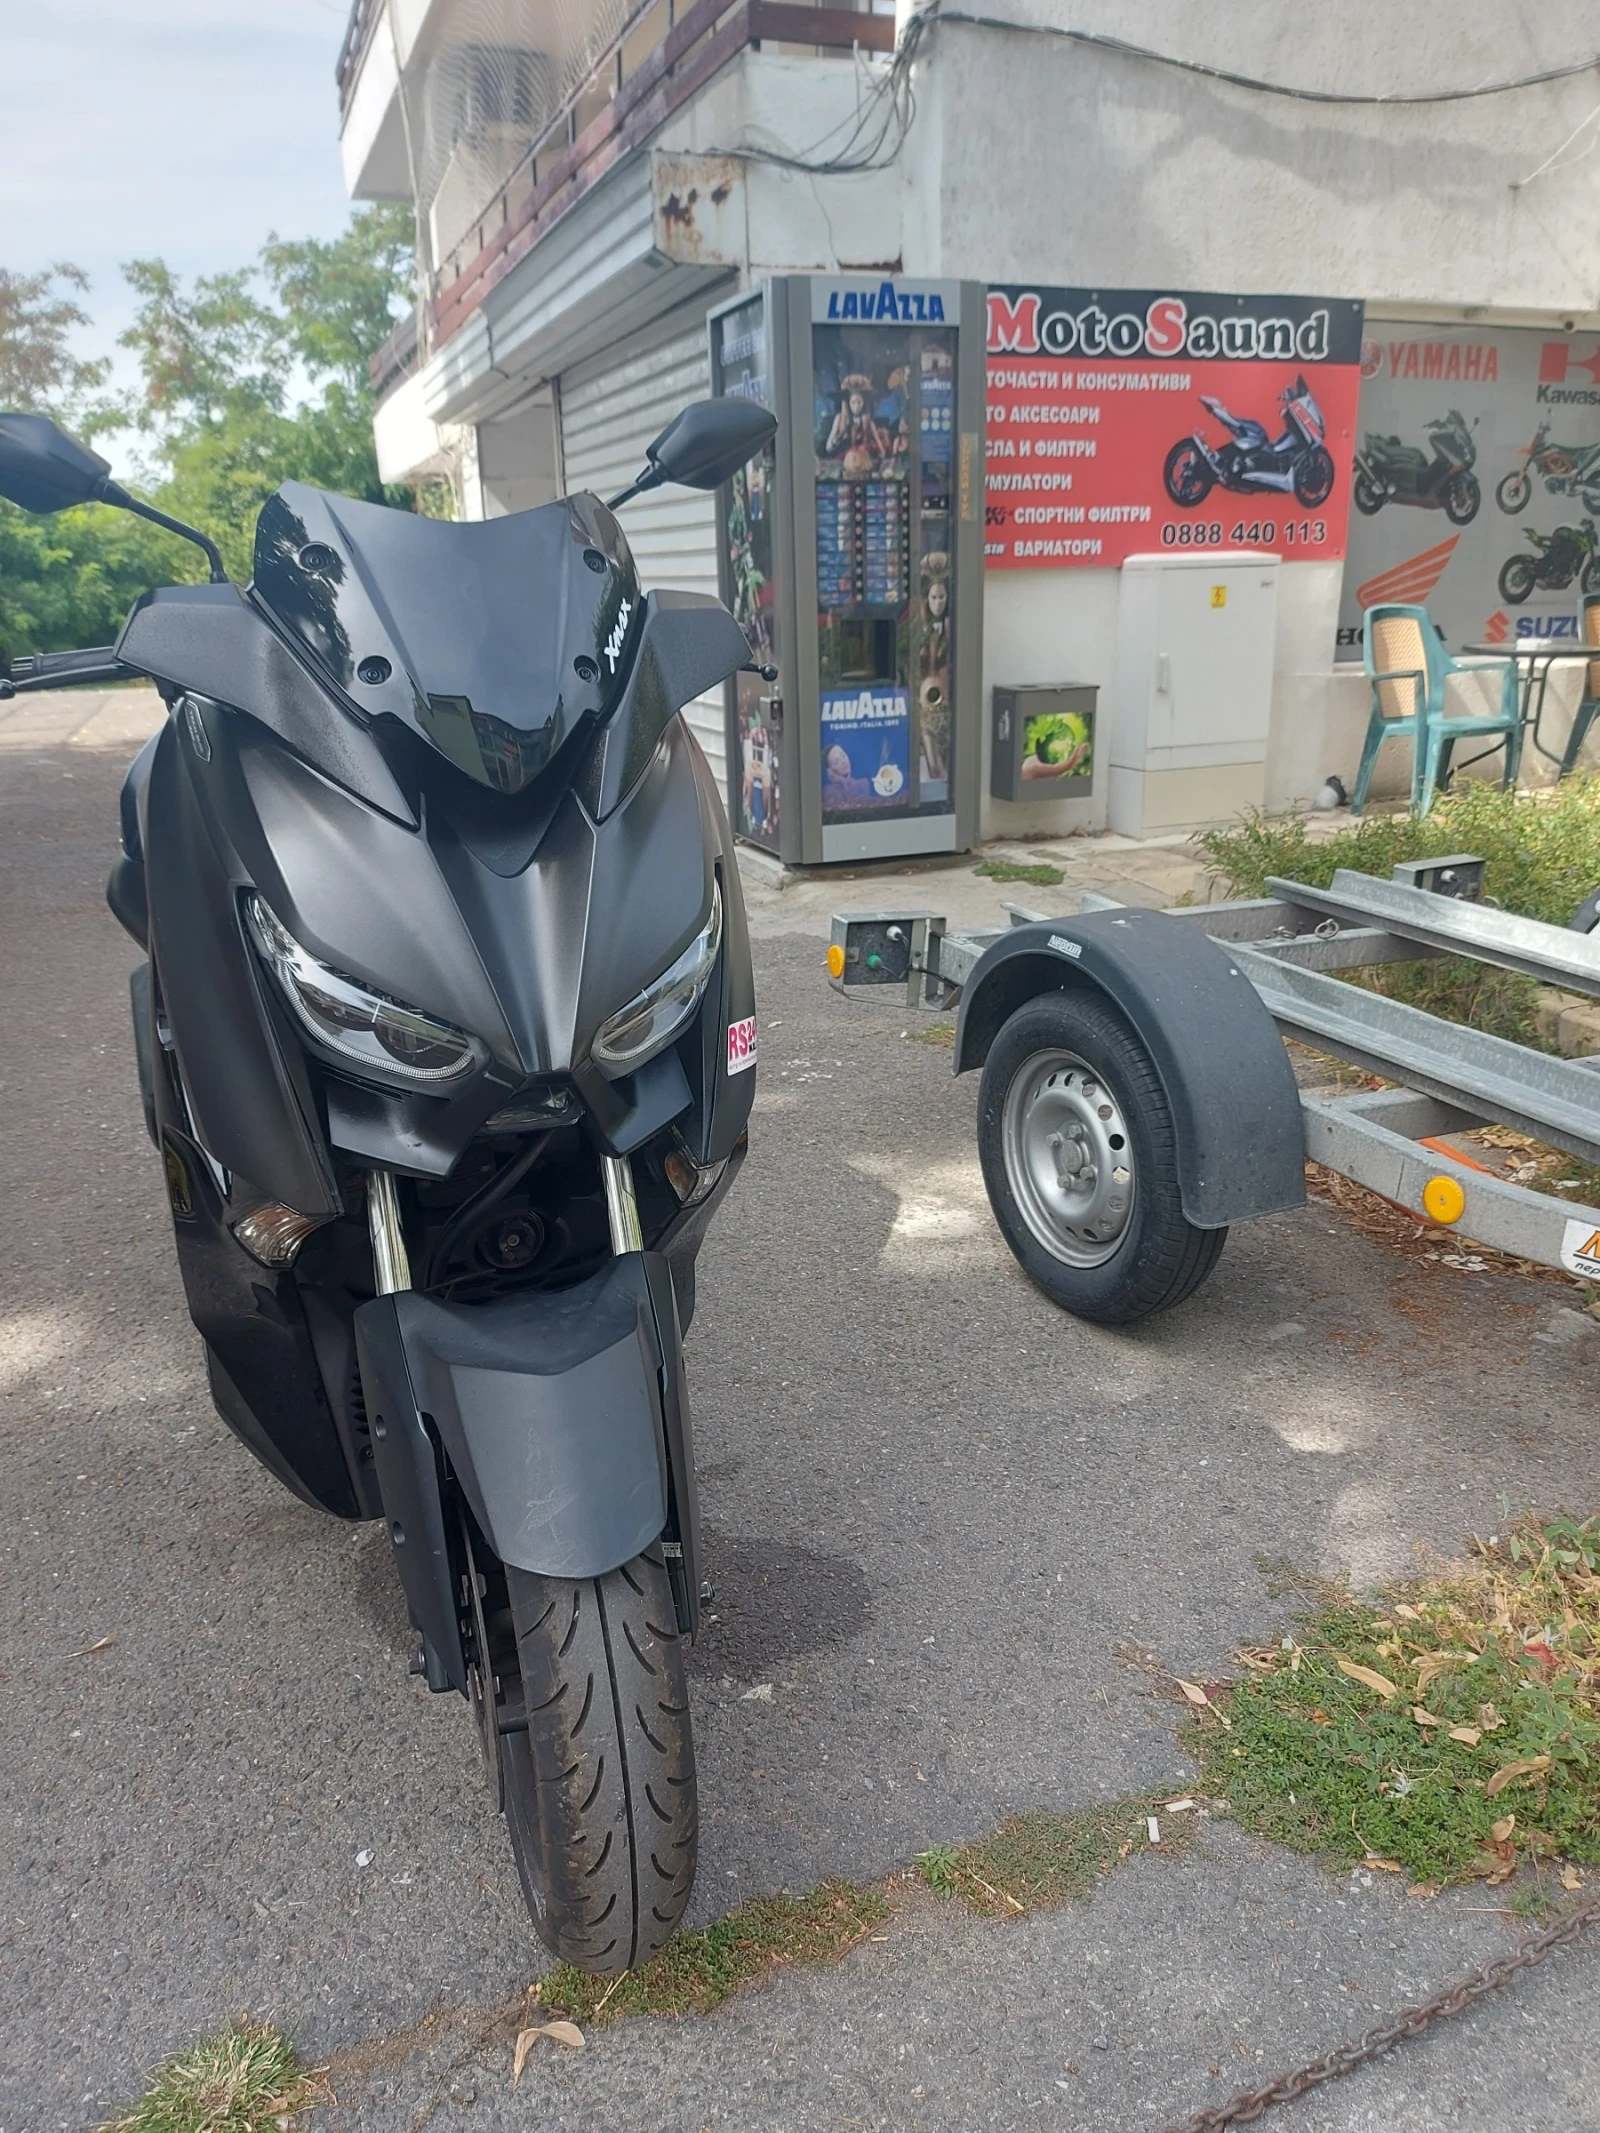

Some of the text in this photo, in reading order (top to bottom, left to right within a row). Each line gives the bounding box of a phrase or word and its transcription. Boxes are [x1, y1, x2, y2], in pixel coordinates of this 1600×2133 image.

[828, 281, 945, 322] LAVAZZA
[987, 292, 1329, 360] MotoSaund
[1388, 341, 1498, 382] YAMAHA
[1062, 373, 1073, 390] И
[1076, 373, 1191, 392] КОНСУМАТИВИ
[1009, 406, 1100, 425] АКСЕСОАРИ
[1019, 440, 1031, 458] И
[1034, 440, 1097, 459] ФИЛТРИ
[1014, 506, 1085, 525] СПОРТНИ
[1088, 505, 1152, 524] ФИЛТРИ
[1161, 521, 1327, 546] 0888 440 113
[1014, 538, 1103, 557] ВАРИАТОРИ
[821, 691, 907, 721] LAVAZZA
[1049, 935, 1083, 957] Neptun
